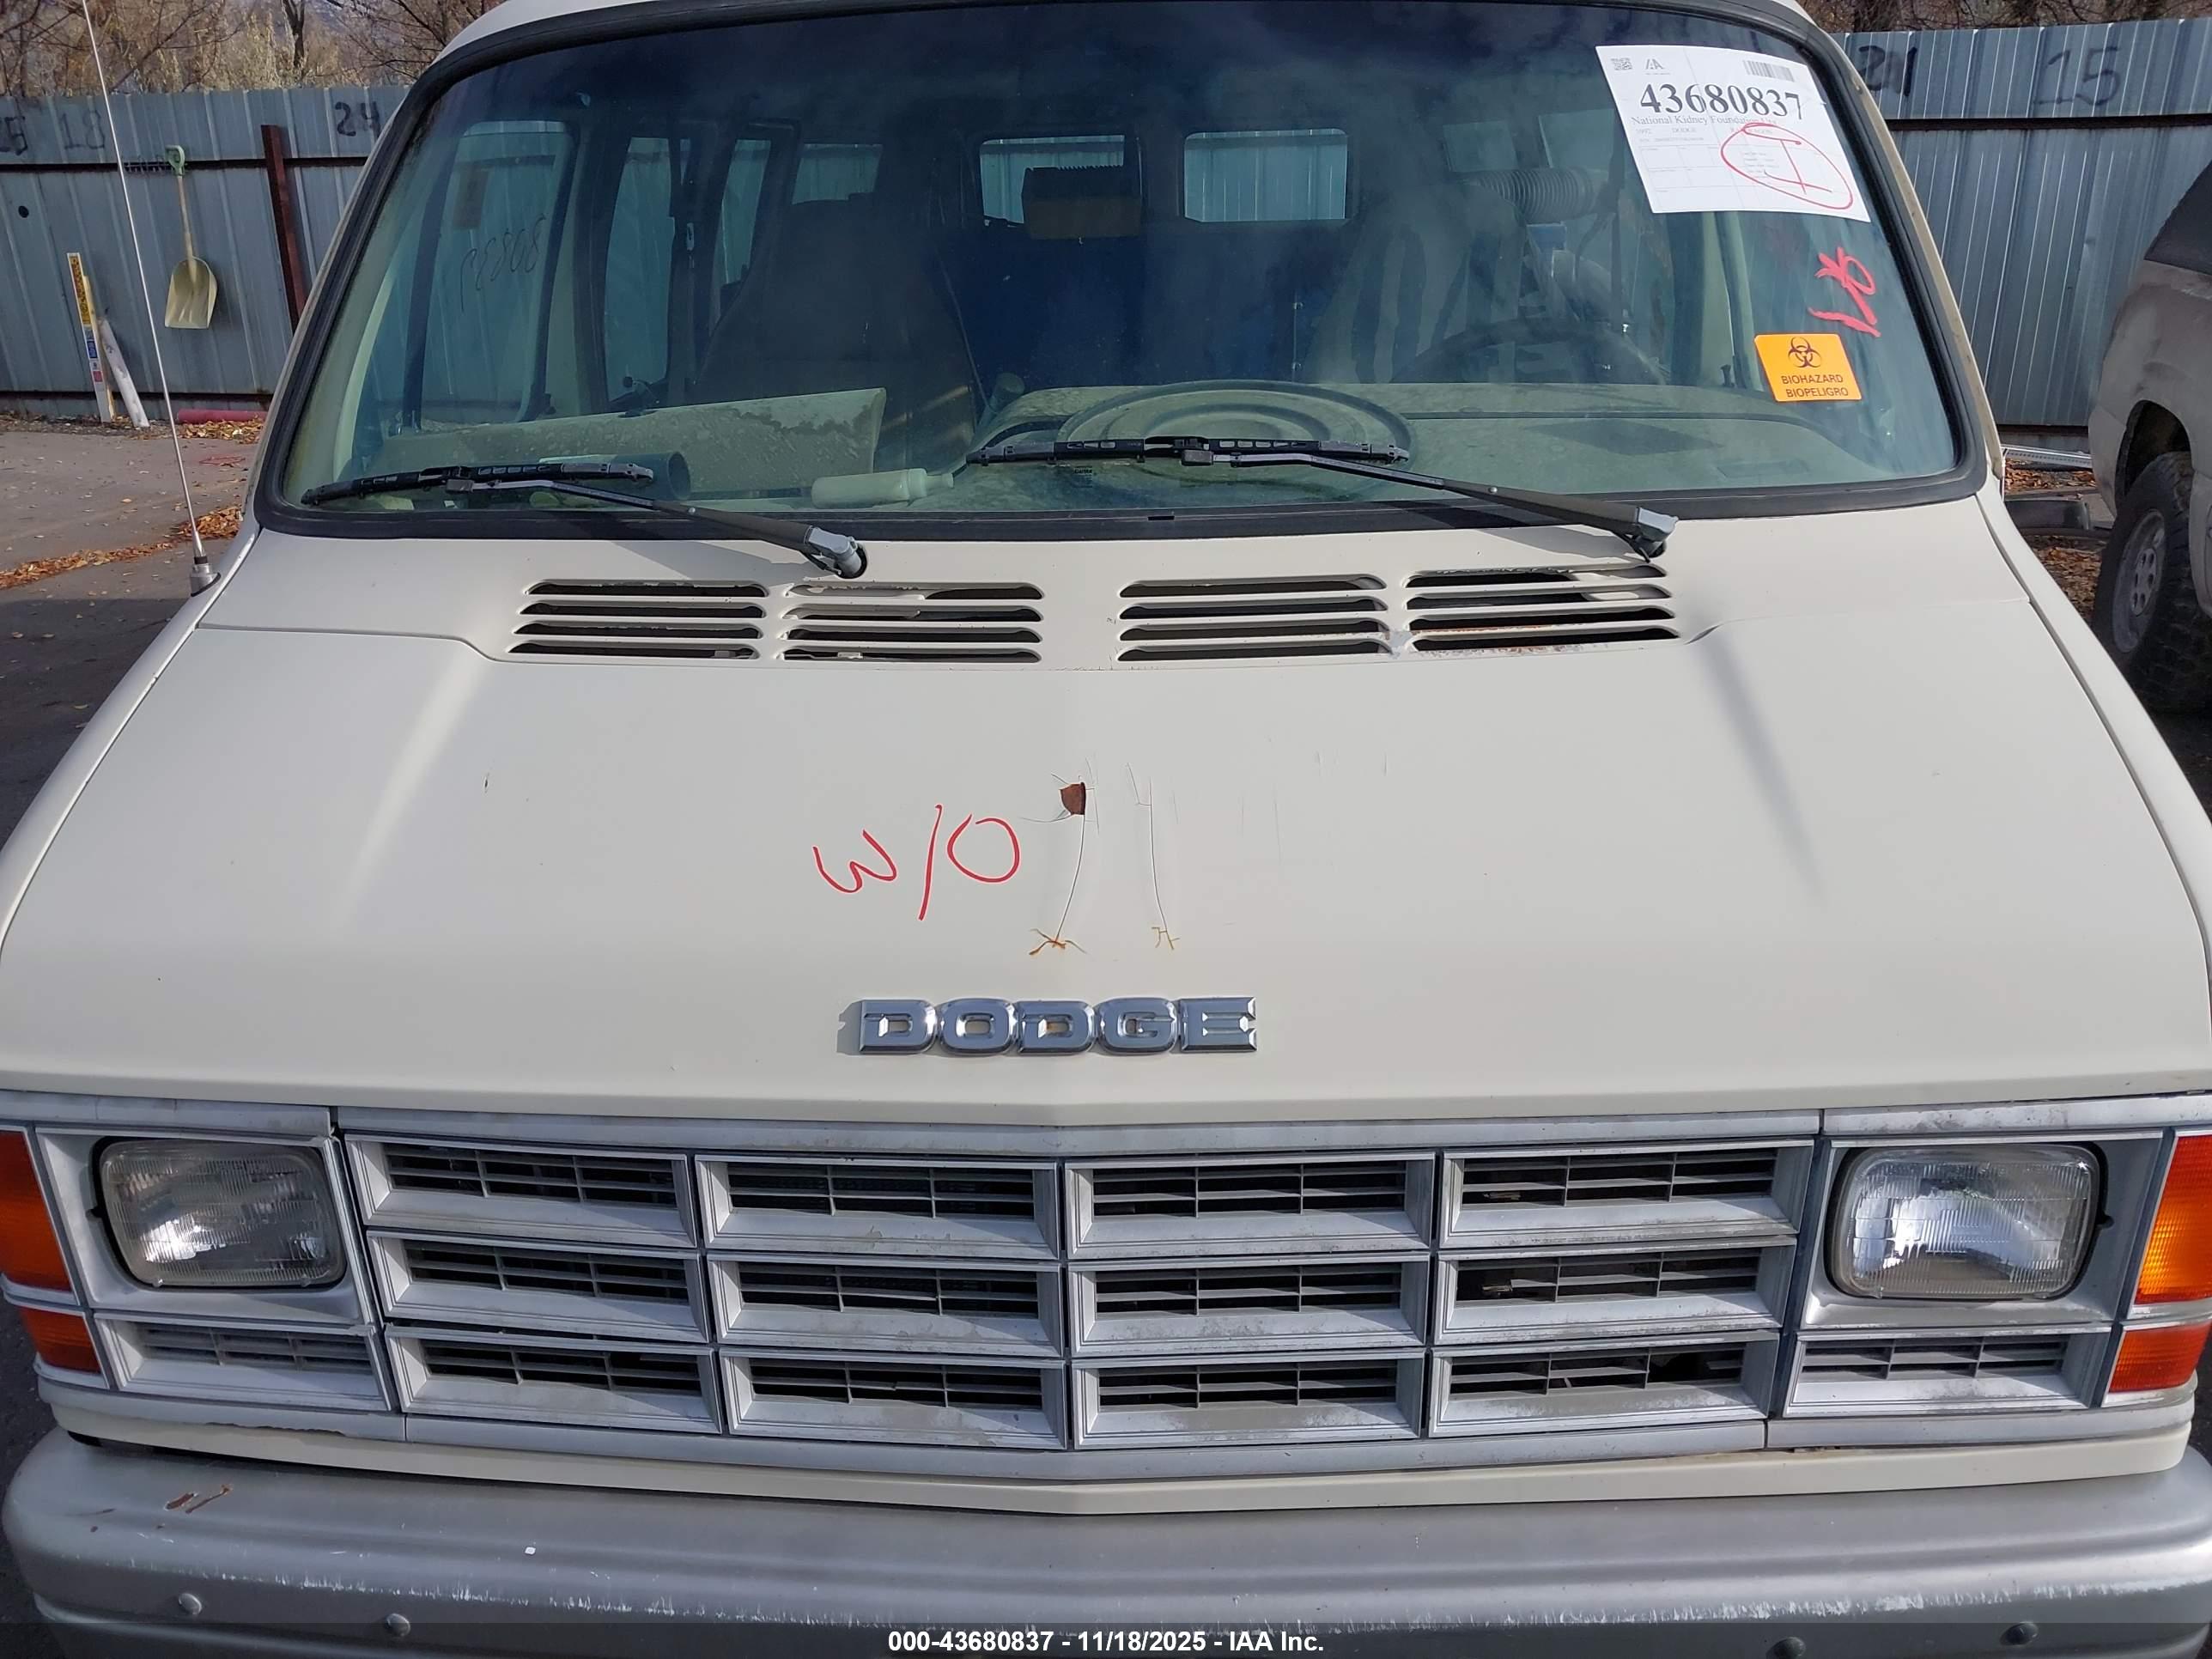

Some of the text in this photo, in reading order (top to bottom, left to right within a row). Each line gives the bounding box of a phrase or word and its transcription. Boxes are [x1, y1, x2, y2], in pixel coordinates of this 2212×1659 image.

[2033, 46, 2122, 106] 15
[334, 100, 381, 138] 24
[1631, 114, 1673, 125] National
[1674, 115, 1708, 125] Kidney
[1639, 83, 1802, 120] 43680837
[0, 116, 28, 156] 5
[1780, 374, 1844, 385] BIOHAZARD
[1785, 387, 1849, 398] BIOPELIGRO
[859, 997, 1258, 1055] DODGE
